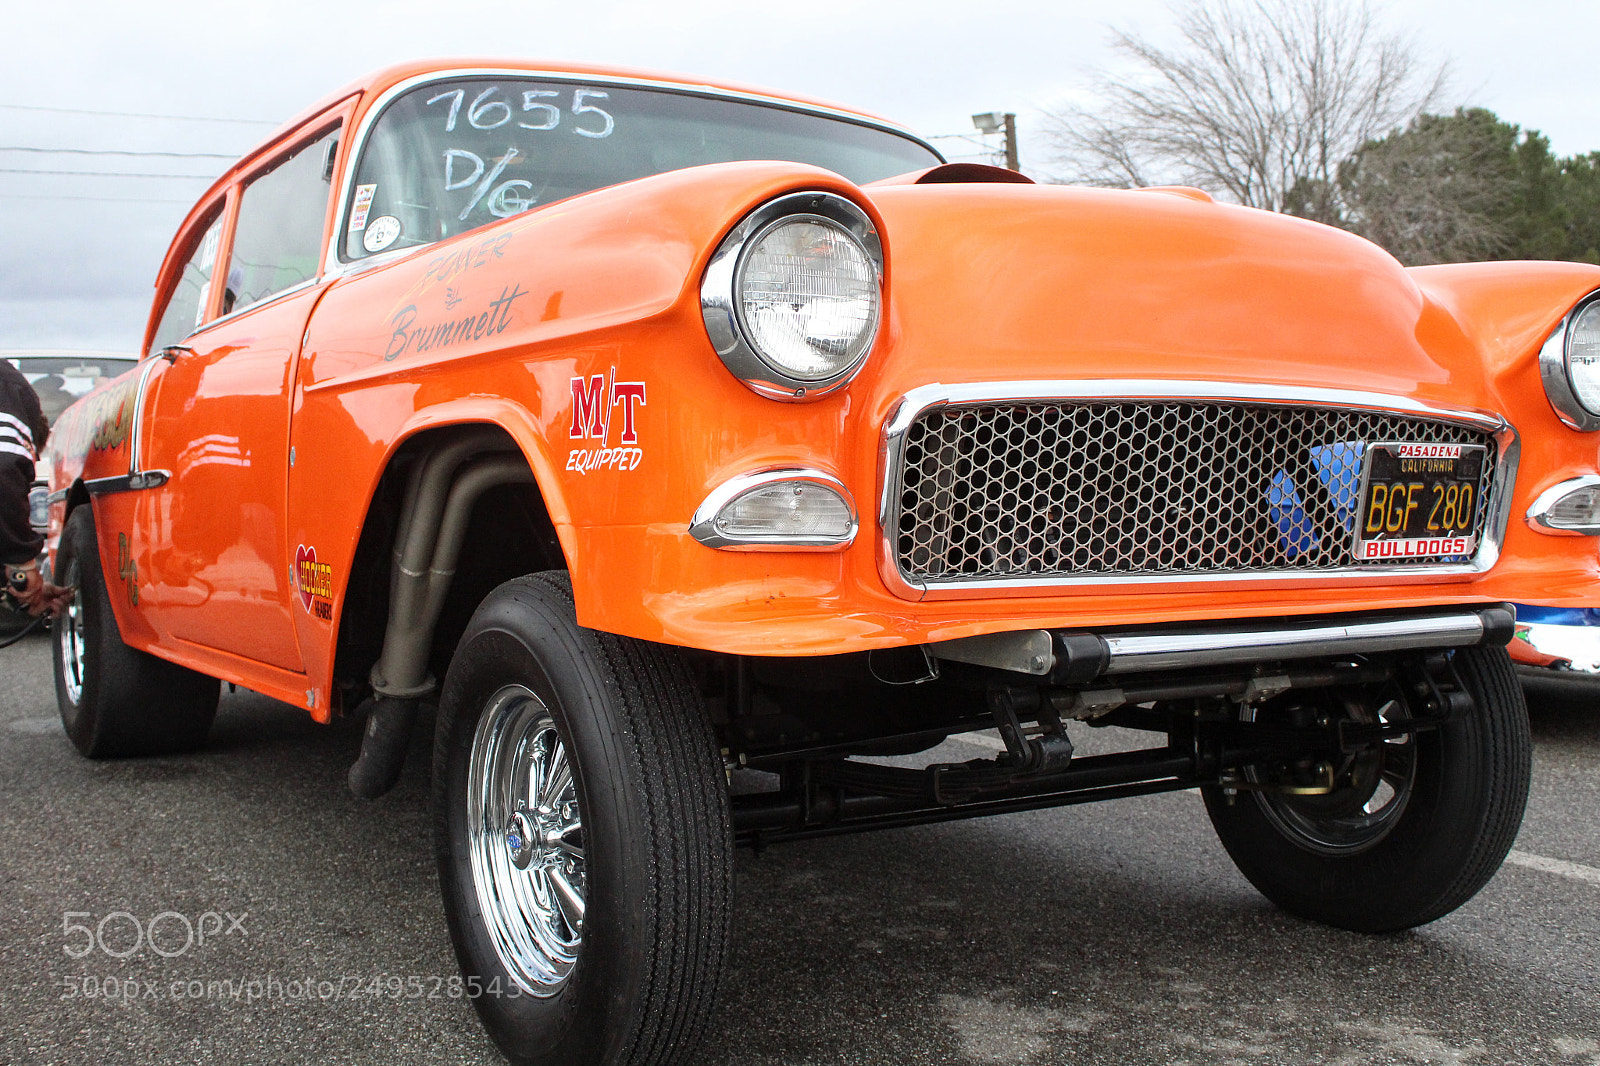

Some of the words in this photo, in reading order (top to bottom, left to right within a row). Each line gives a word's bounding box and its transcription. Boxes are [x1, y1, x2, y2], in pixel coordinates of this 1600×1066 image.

[442, 147, 536, 221] D/G
[384, 283, 529, 362] Brummett
[569, 365, 647, 448] M/T
[565, 447, 643, 475] EQUIPPED
[1399, 445, 1460, 457] PASADENA
[1401, 459, 1454, 473] CALIFORNIA
[1366, 484, 1425, 532] BGF
[1426, 484, 1474, 531] 280
[1366, 539, 1466, 557] BULLDOGS
[300, 560, 332, 600] HOOKER
